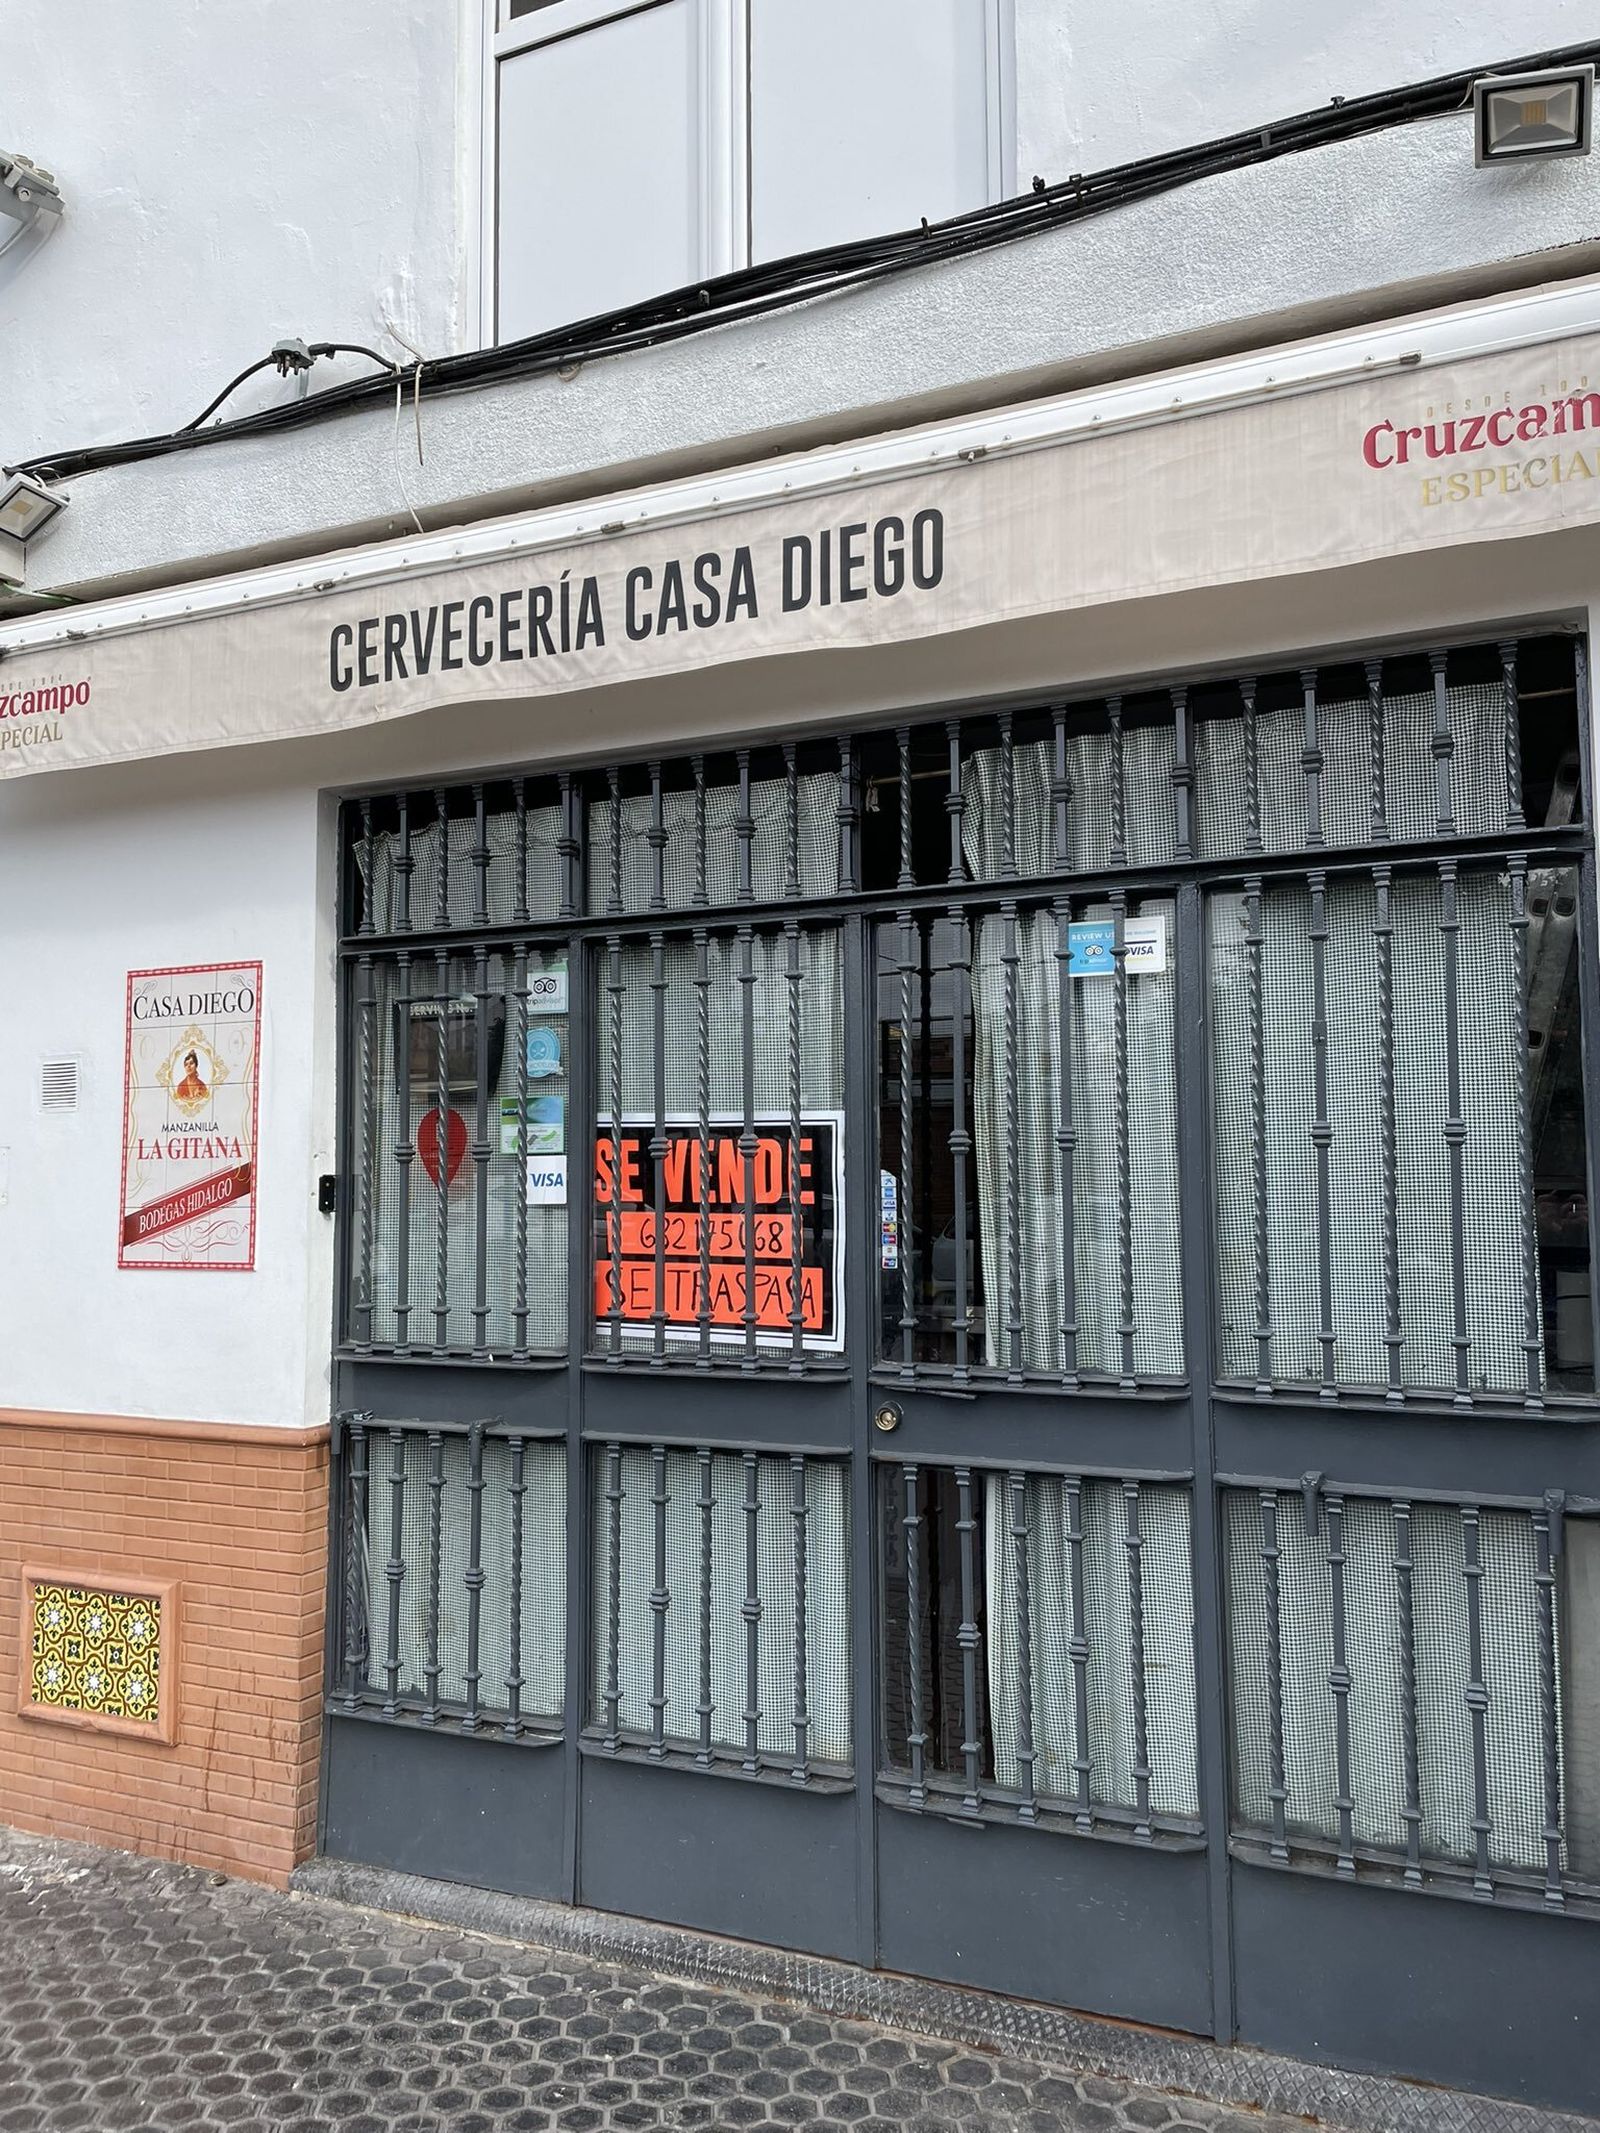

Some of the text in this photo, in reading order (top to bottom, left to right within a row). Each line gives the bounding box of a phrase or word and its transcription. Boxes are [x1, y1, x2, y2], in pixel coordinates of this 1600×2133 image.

[1427, 391, 1510, 418] DESDE
[1362, 392, 1600, 469] Cruzcam
[1421, 447, 1600, 507] ESPECIA
[330, 508, 945, 692] CERVECERÍA CASA DIEGO
[1071, 932, 1103, 940] REVIEW
[1130, 946, 1154, 955] VISA
[134, 988, 254, 1020] CASA DIEGO
[162, 1122, 219, 1132] MANZANILLA
[137, 1136, 242, 1160] LA GITANA
[530, 1173, 564, 1187] VISA
[595, 1138, 815, 1205] SE VENDE
[139, 1178, 232, 1234] BODEGAS HIDALGO
[605, 1266, 652, 1311] SE
